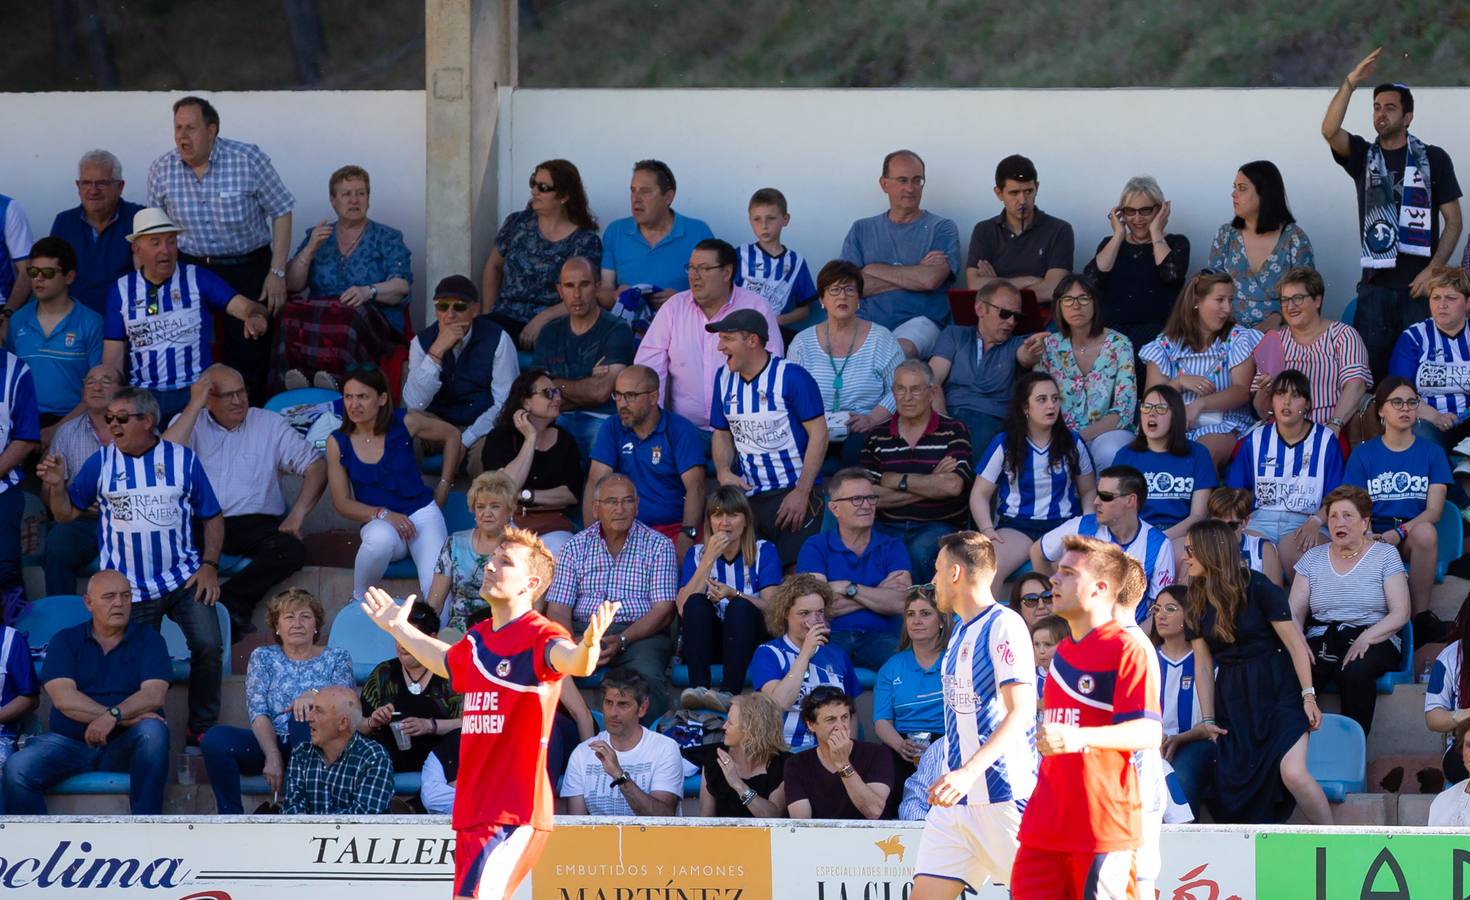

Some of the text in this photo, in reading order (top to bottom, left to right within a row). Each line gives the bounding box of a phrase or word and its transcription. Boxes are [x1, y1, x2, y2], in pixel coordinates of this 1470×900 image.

[743, 420, 771, 432] REAL
[131, 496, 167, 506] REAL
[482, 691, 499, 711] DE
[556, 864, 746, 878] EMBUTIDOS Y JAMONES
